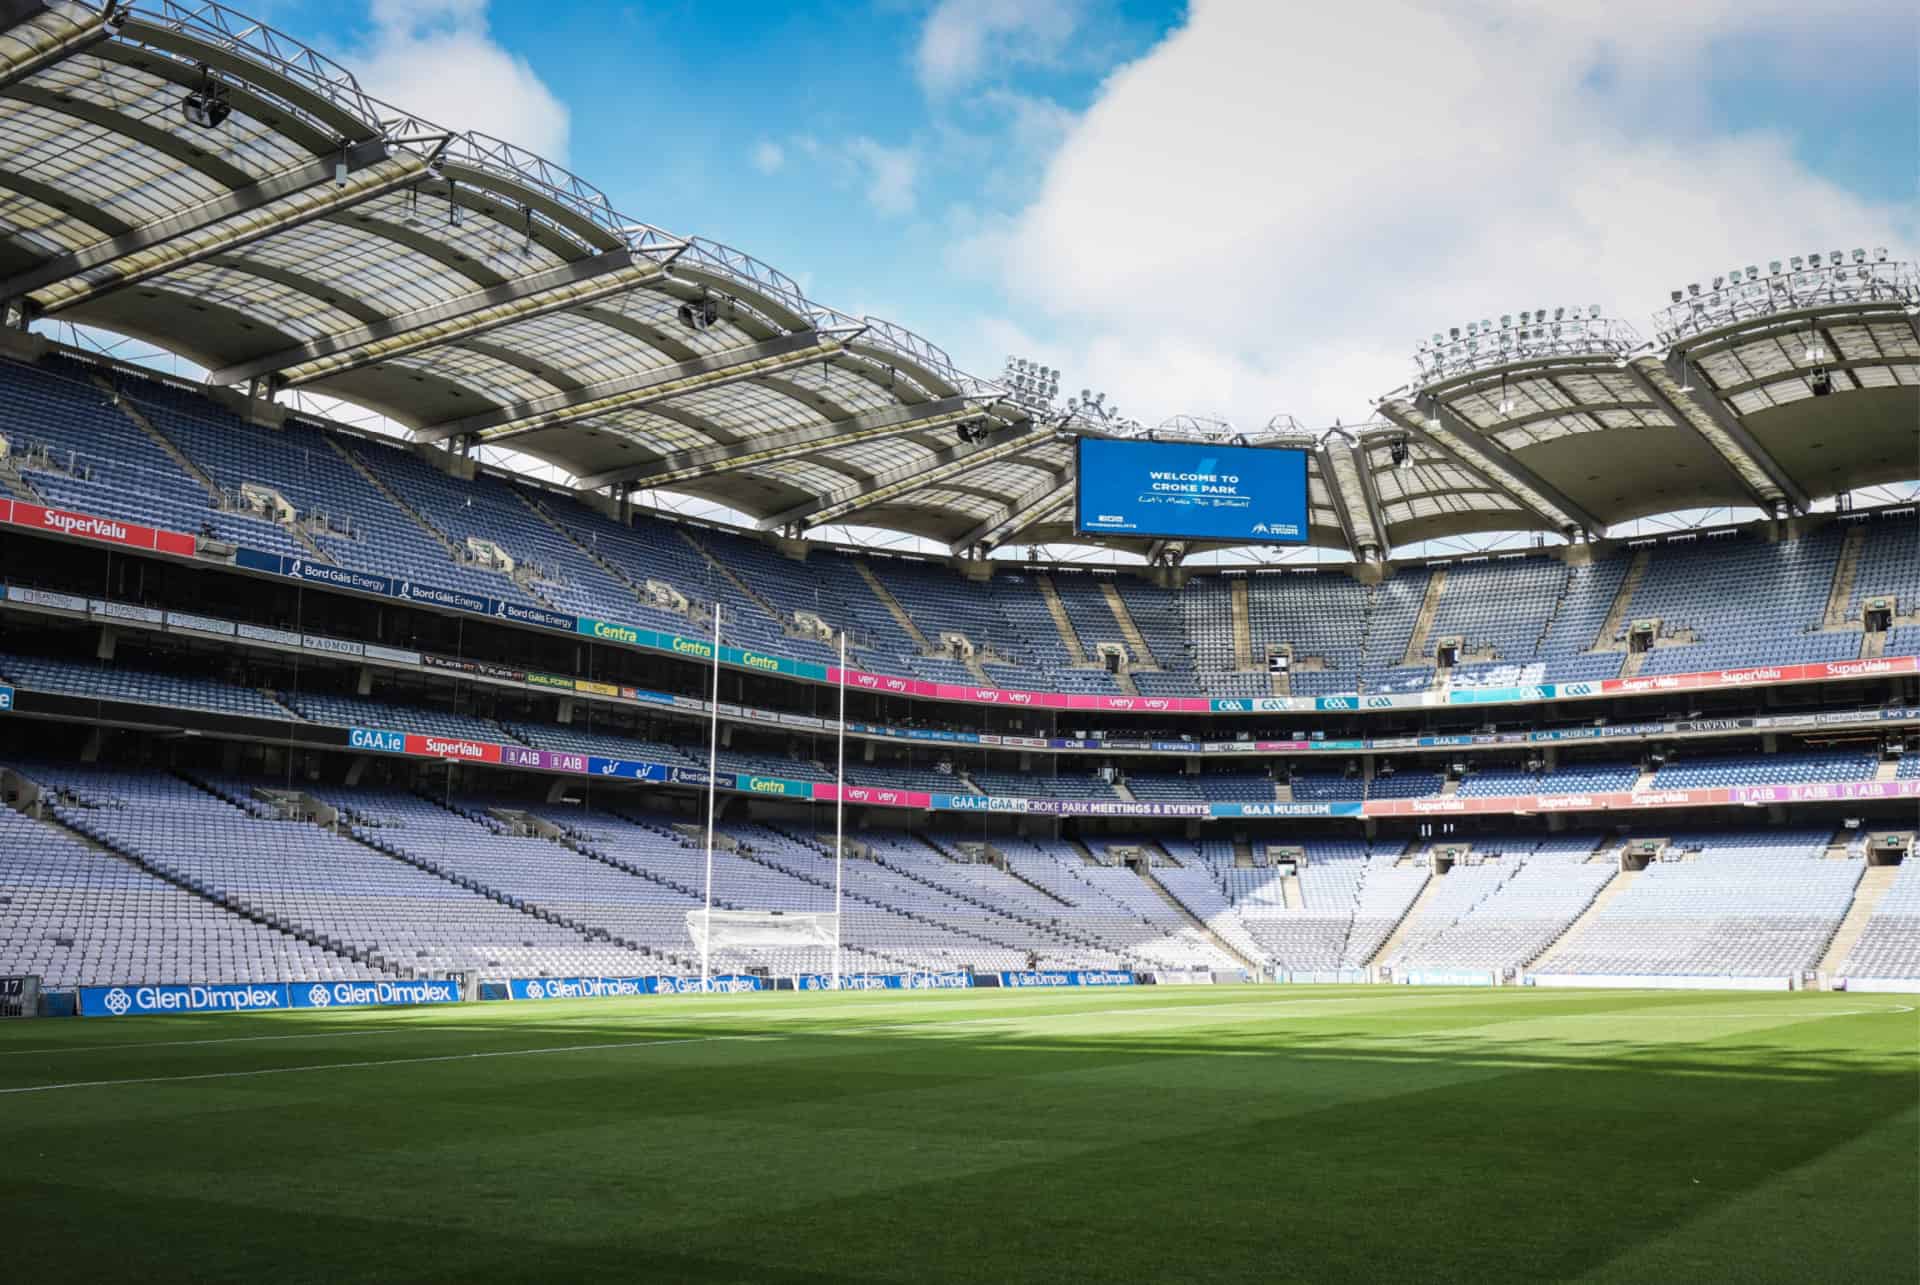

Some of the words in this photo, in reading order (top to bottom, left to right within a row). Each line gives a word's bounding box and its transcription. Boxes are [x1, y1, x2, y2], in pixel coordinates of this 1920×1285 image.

[1150, 472, 1217, 482] WELCOME
[1221, 475, 1239, 483] TO
[1152, 483, 1198, 492] CROKE
[1201, 485, 1237, 494] PARK
[44, 510, 127, 540] SuperValu
[305, 565, 329, 578] Bord
[352, 574, 385, 592] Energy
[412, 586, 434, 599] Bord
[455, 595, 483, 610] Energy
[507, 606, 528, 618] Bord
[545, 614, 572, 629] Energy
[594, 622, 637, 642] Centra
[673, 637, 711, 657] Centra
[743, 652, 779, 671] Centra
[1826, 659, 1891, 674] SuperValu
[857, 674, 878, 688] very
[886, 678, 907, 692] very
[1622, 677, 1678, 690] SuperValu
[1720, 669, 1781, 684] SuperValu
[976, 689, 999, 702] very
[1008, 691, 1031, 704] very
[1109, 698, 1134, 709] very
[1144, 700, 1169, 711] very
[1690, 719, 1741, 732] NEWPARK
[351, 729, 401, 750] GAA.ie
[426, 738, 483, 757] SuperValu
[519, 751, 541, 765] AIB
[562, 757, 582, 769] AIB
[750, 777, 785, 794] Centra
[848, 788, 869, 801] very
[877, 790, 898, 803] very
[1751, 788, 1775, 800] AIB
[951, 796, 987, 810] GAA.ie
[1027, 801, 1059, 812] CROKE
[1061, 802, 1088, 813] PARK
[1091, 803, 1150, 814] MEETINGS
[1152, 804, 1161, 814] &
[1164, 804, 1210, 814] EVENTS
[1242, 803, 1271, 814] GAA
[1274, 803, 1329, 814] MUSEUM
[3, 980, 19, 993] 17
[334, 983, 451, 1004] GlenDimplex
[546, 978, 640, 997] GlenDimplex
[136, 986, 279, 1012] GlenDimplex
